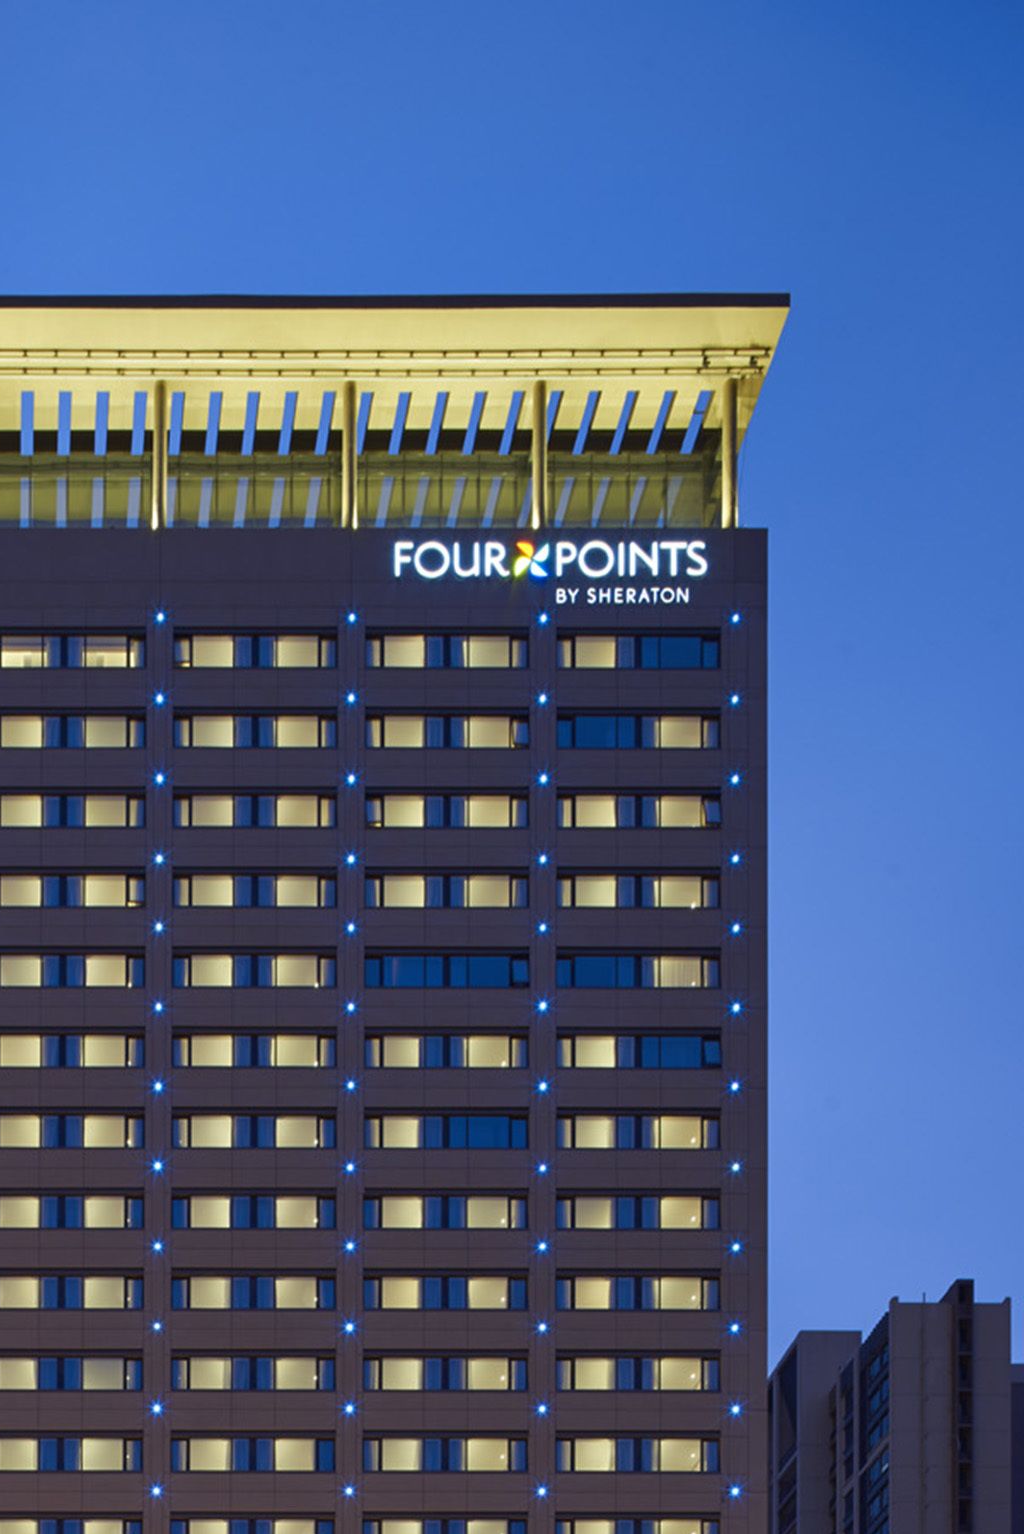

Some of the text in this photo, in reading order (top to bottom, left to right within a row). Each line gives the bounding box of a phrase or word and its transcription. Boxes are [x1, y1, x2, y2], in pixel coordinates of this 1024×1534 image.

[393, 540, 708, 578] FOUR POINTS
[555, 588, 690, 604] BY SHERATON
